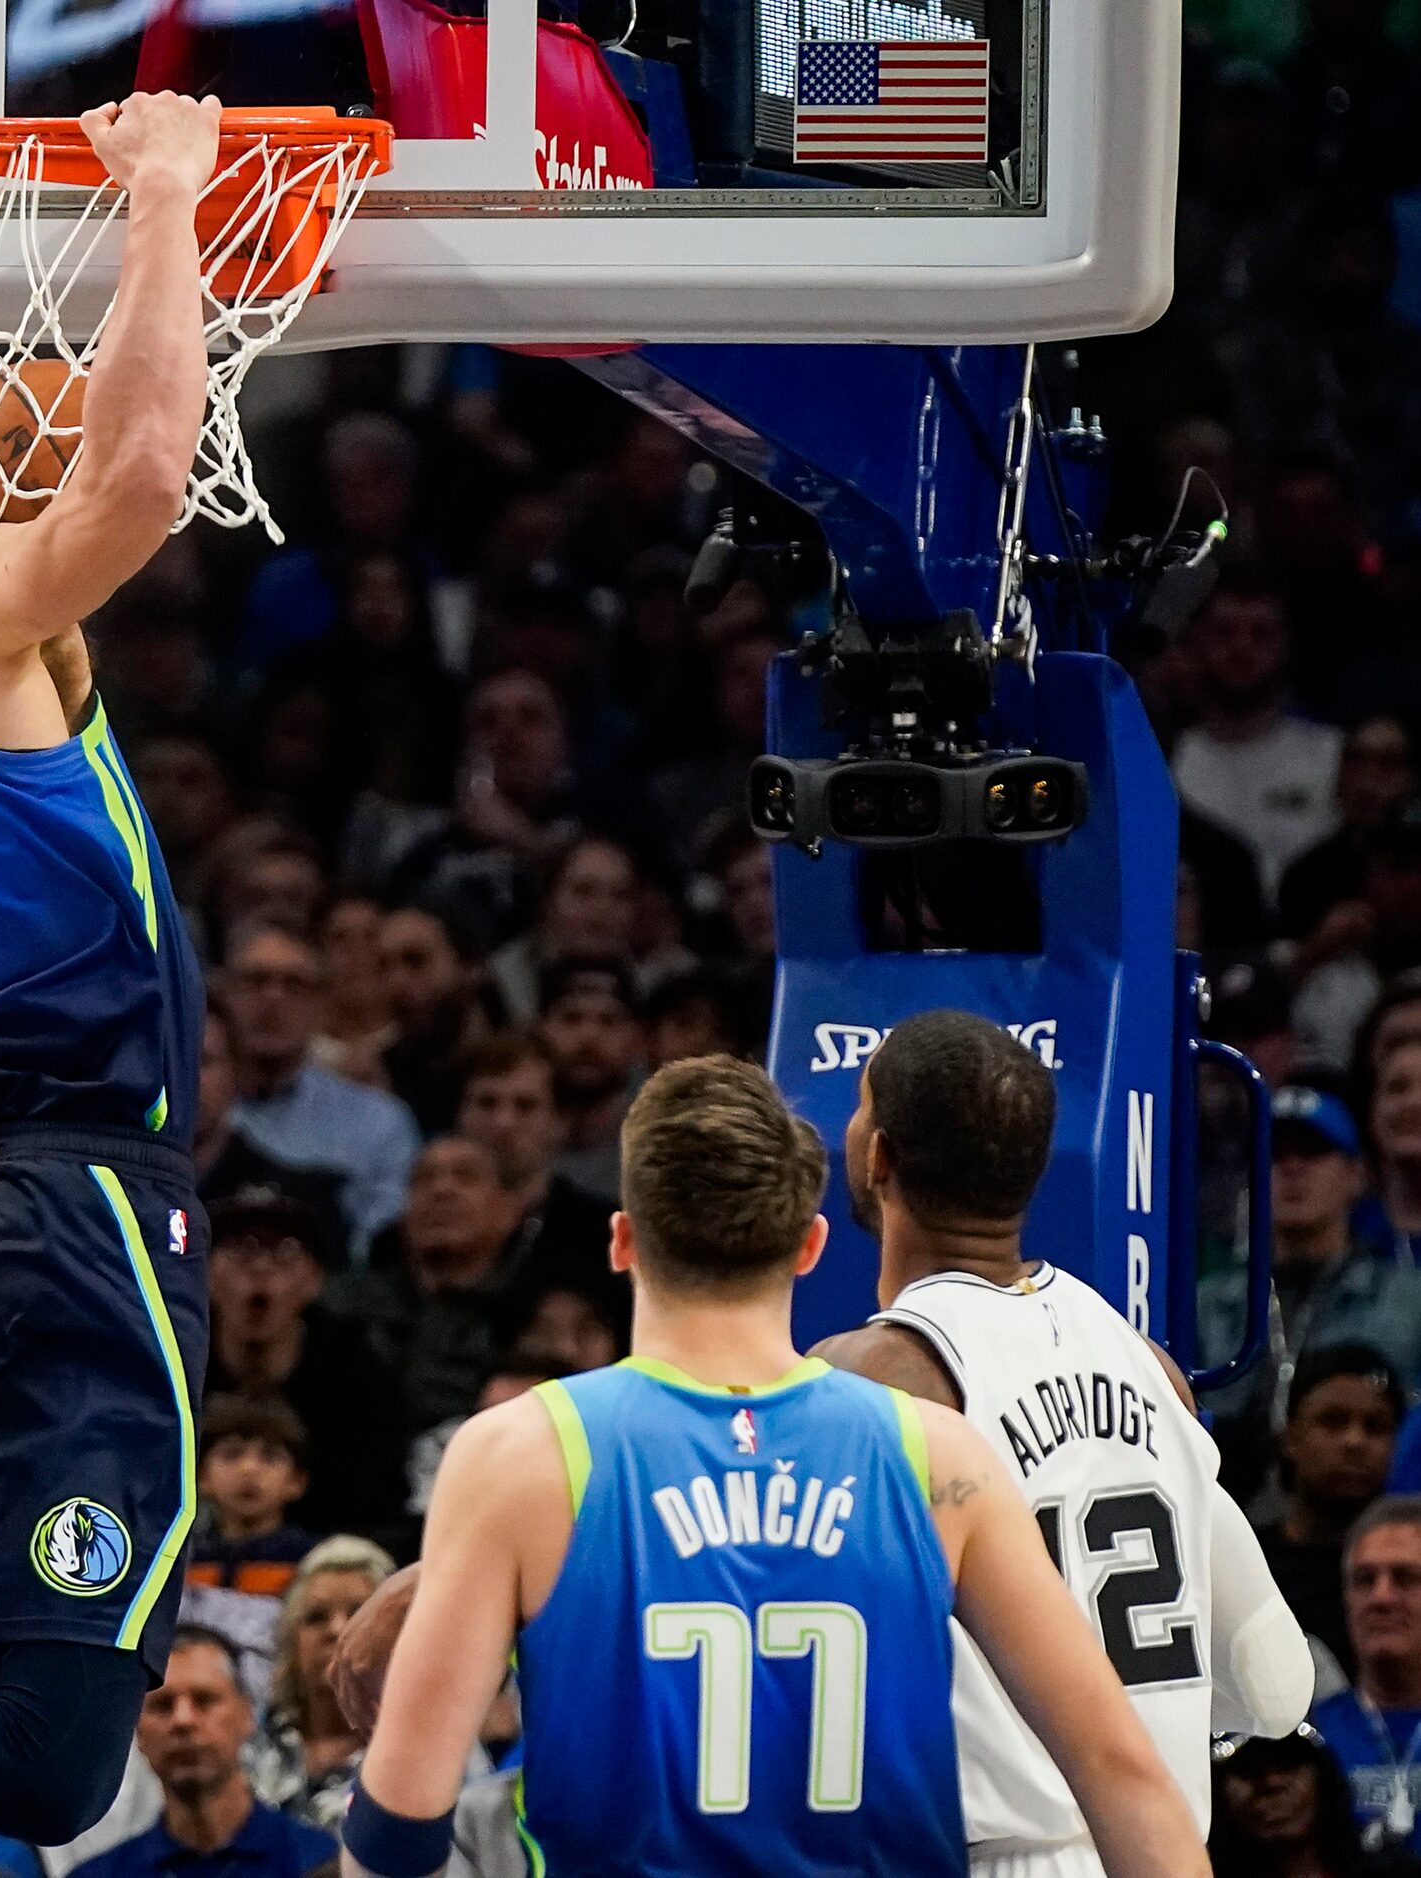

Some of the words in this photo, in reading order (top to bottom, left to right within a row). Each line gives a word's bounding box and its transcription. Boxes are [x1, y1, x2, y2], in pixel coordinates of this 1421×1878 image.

[999, 1371, 1160, 1479] ALDRIDGE
[652, 1458, 857, 1560] DONČIĆ
[644, 1601, 869, 1814] 77
